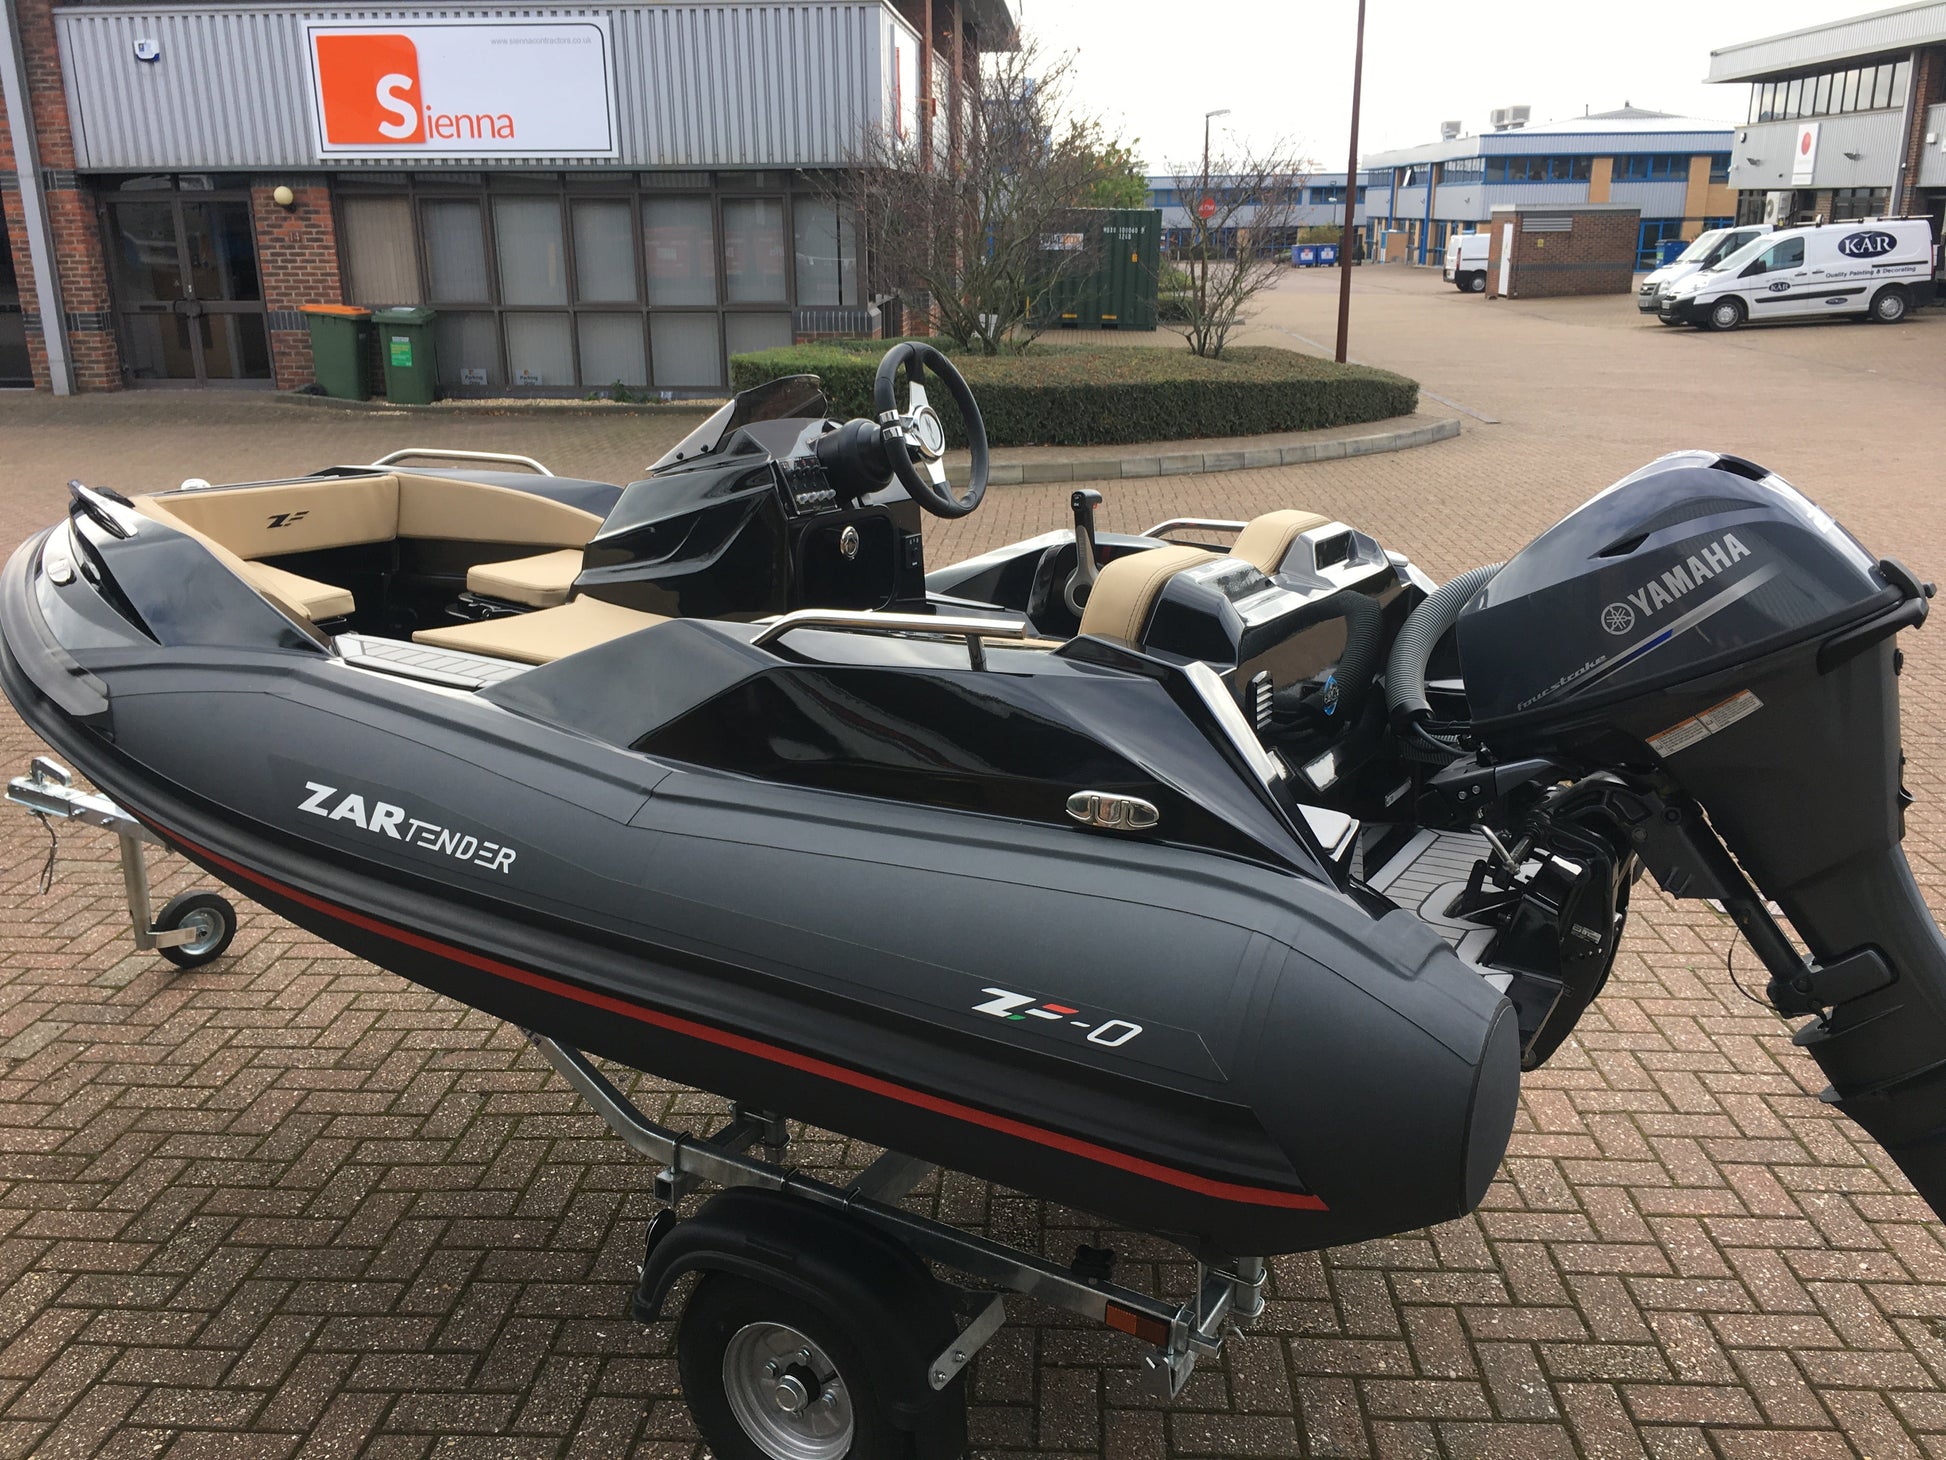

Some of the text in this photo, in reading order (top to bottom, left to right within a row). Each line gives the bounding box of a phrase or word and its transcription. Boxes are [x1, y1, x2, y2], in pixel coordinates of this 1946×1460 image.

[376, 73, 515, 139] Sienna
[1825, 271, 1847, 279] Quality
[1883, 266, 1917, 274] Decorating
[1627, 532, 1752, 617] YAMAHA
[1517, 655, 1607, 711] fourstroke
